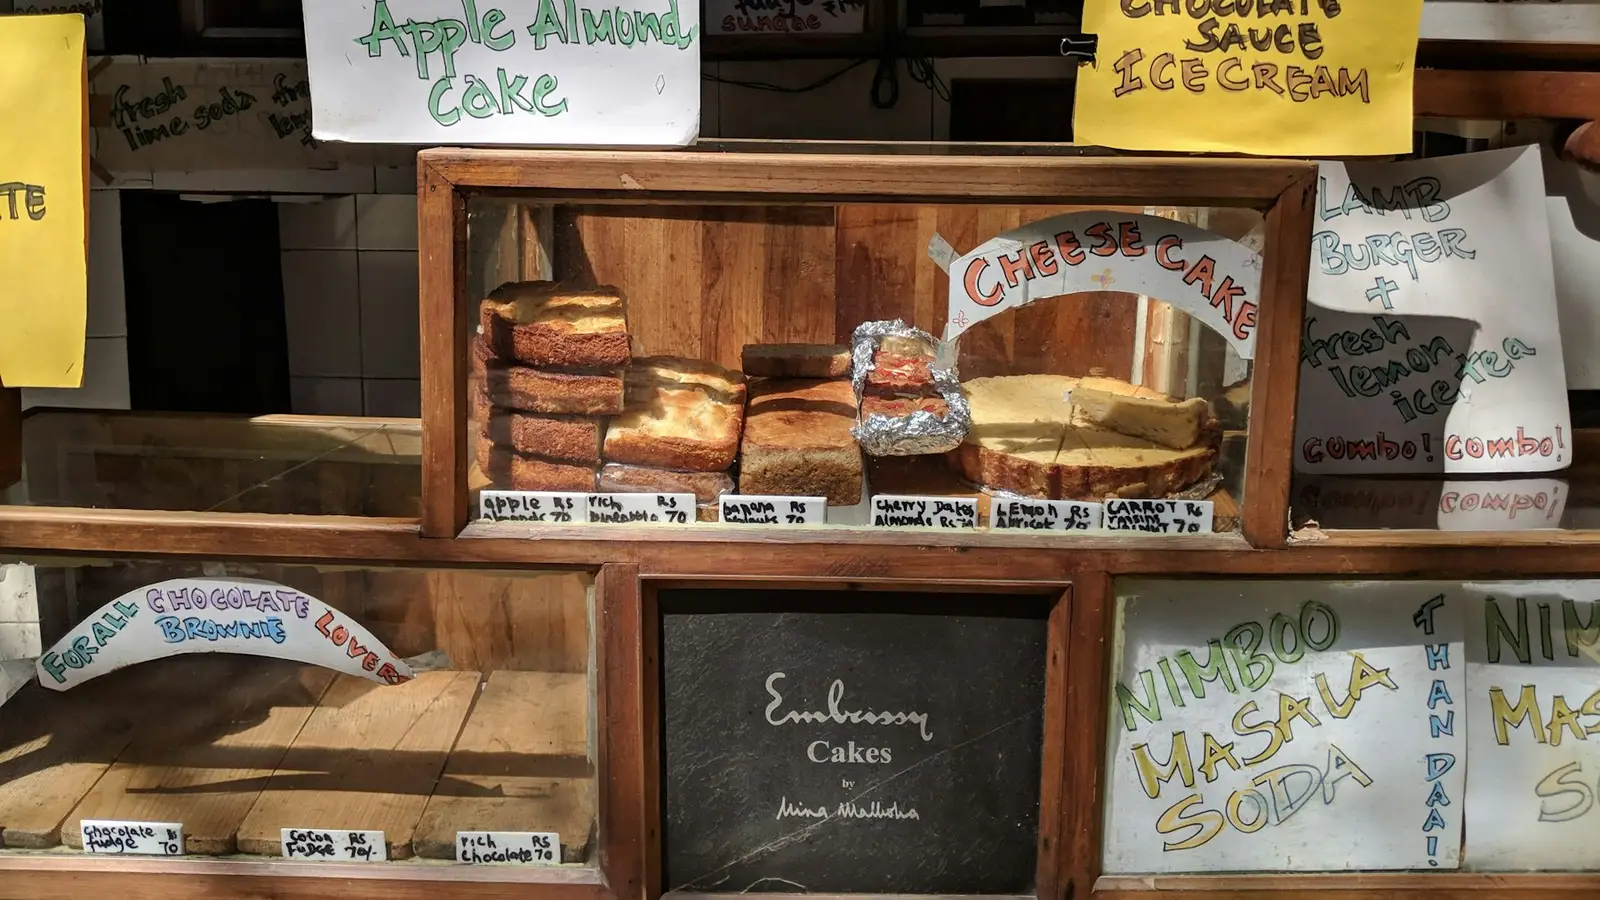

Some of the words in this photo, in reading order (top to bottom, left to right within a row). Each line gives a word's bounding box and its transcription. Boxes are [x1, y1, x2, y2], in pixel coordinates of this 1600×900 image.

[354, 0, 515, 79] Apple
[527, 0, 697, 50] Almond
[1183, 18, 1324, 59] SAUCE
[111, 77, 186, 128] fresh
[123, 117, 189, 151] lime
[195, 86, 257, 130] soda
[0, 182, 46, 221] TE
[1320, 176, 1451, 222] LAMB
[1311, 228, 1476, 281] BURGER
[1301, 316, 1410, 368] fresh
[1328, 336, 1453, 397] lemon
[484, 496, 541, 513] apple
[550, 511, 572, 522] 70
[665, 510, 688, 523] 70
[1063, 517, 1092, 530] 70
[1107, 501, 1177, 516] CARROT
[1173, 518, 1200, 533] 70
[146, 587, 309, 619] CHOCOLATE
[154, 615, 286, 644] BROWNIE
[315, 607, 411, 686] LOVER
[1115, 600, 1337, 731] NIMBOO
[1131, 651, 1398, 799] MASALA
[807, 740, 892, 764] Cakes
[842, 779, 855, 790] by
[1156, 743, 1373, 852] SODA
[1535, 761, 1600, 822] S
[86, 835, 139, 853] fudge
[158, 841, 178, 854] 70
[461, 834, 497, 849] rich
[534, 848, 553, 861] 70
